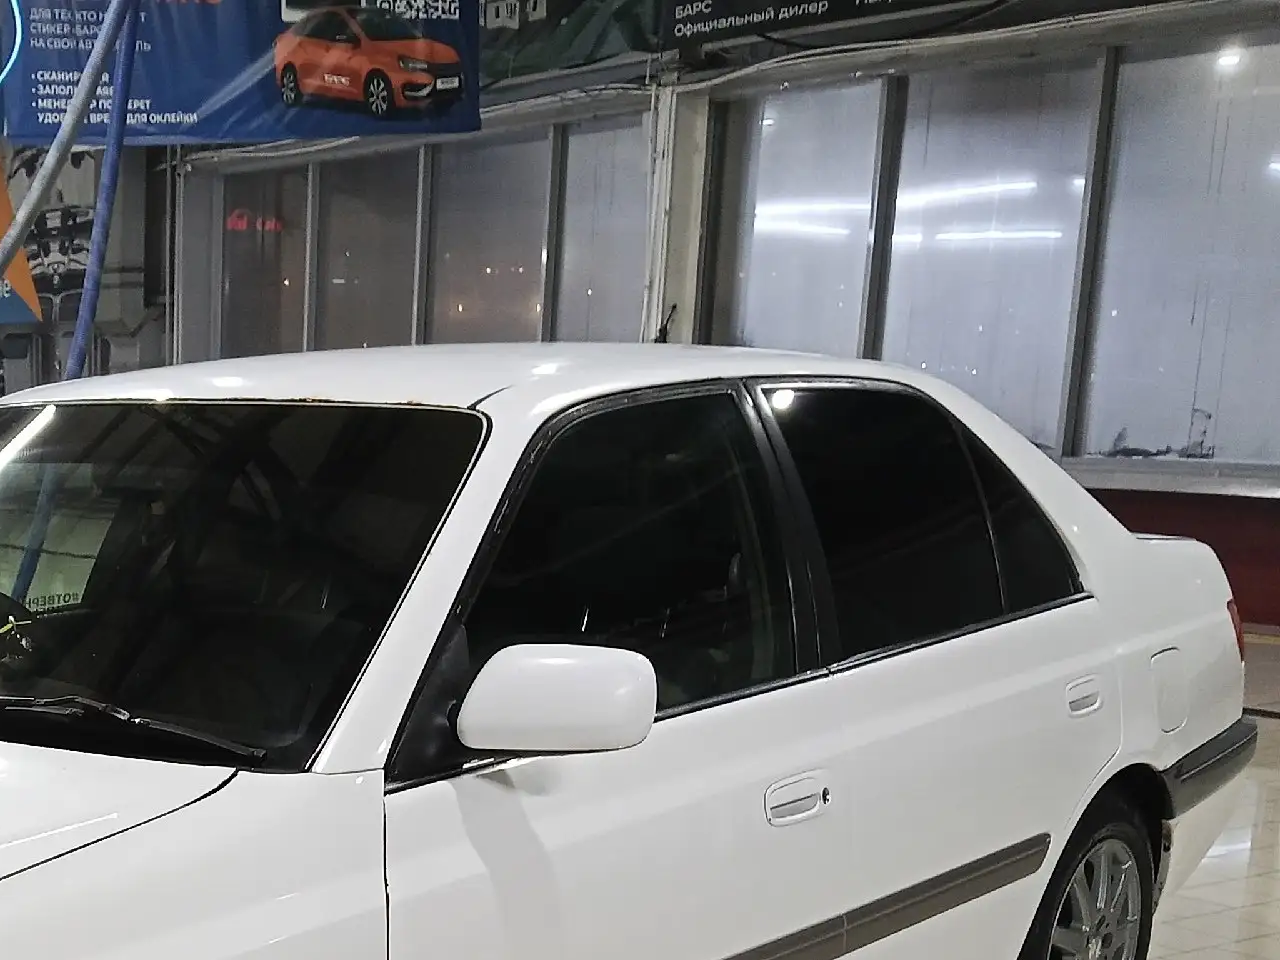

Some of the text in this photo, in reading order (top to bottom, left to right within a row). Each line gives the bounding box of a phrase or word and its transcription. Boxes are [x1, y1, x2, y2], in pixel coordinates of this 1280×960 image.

[675, 0, 712, 19] БАРС
[674, 0, 828, 38] Официальный дилер
[29, 22, 72, 34] СТИКЕР
[29, 37, 45, 48] НА
[149, 110, 199, 125] ОКЛЕЙКИ
